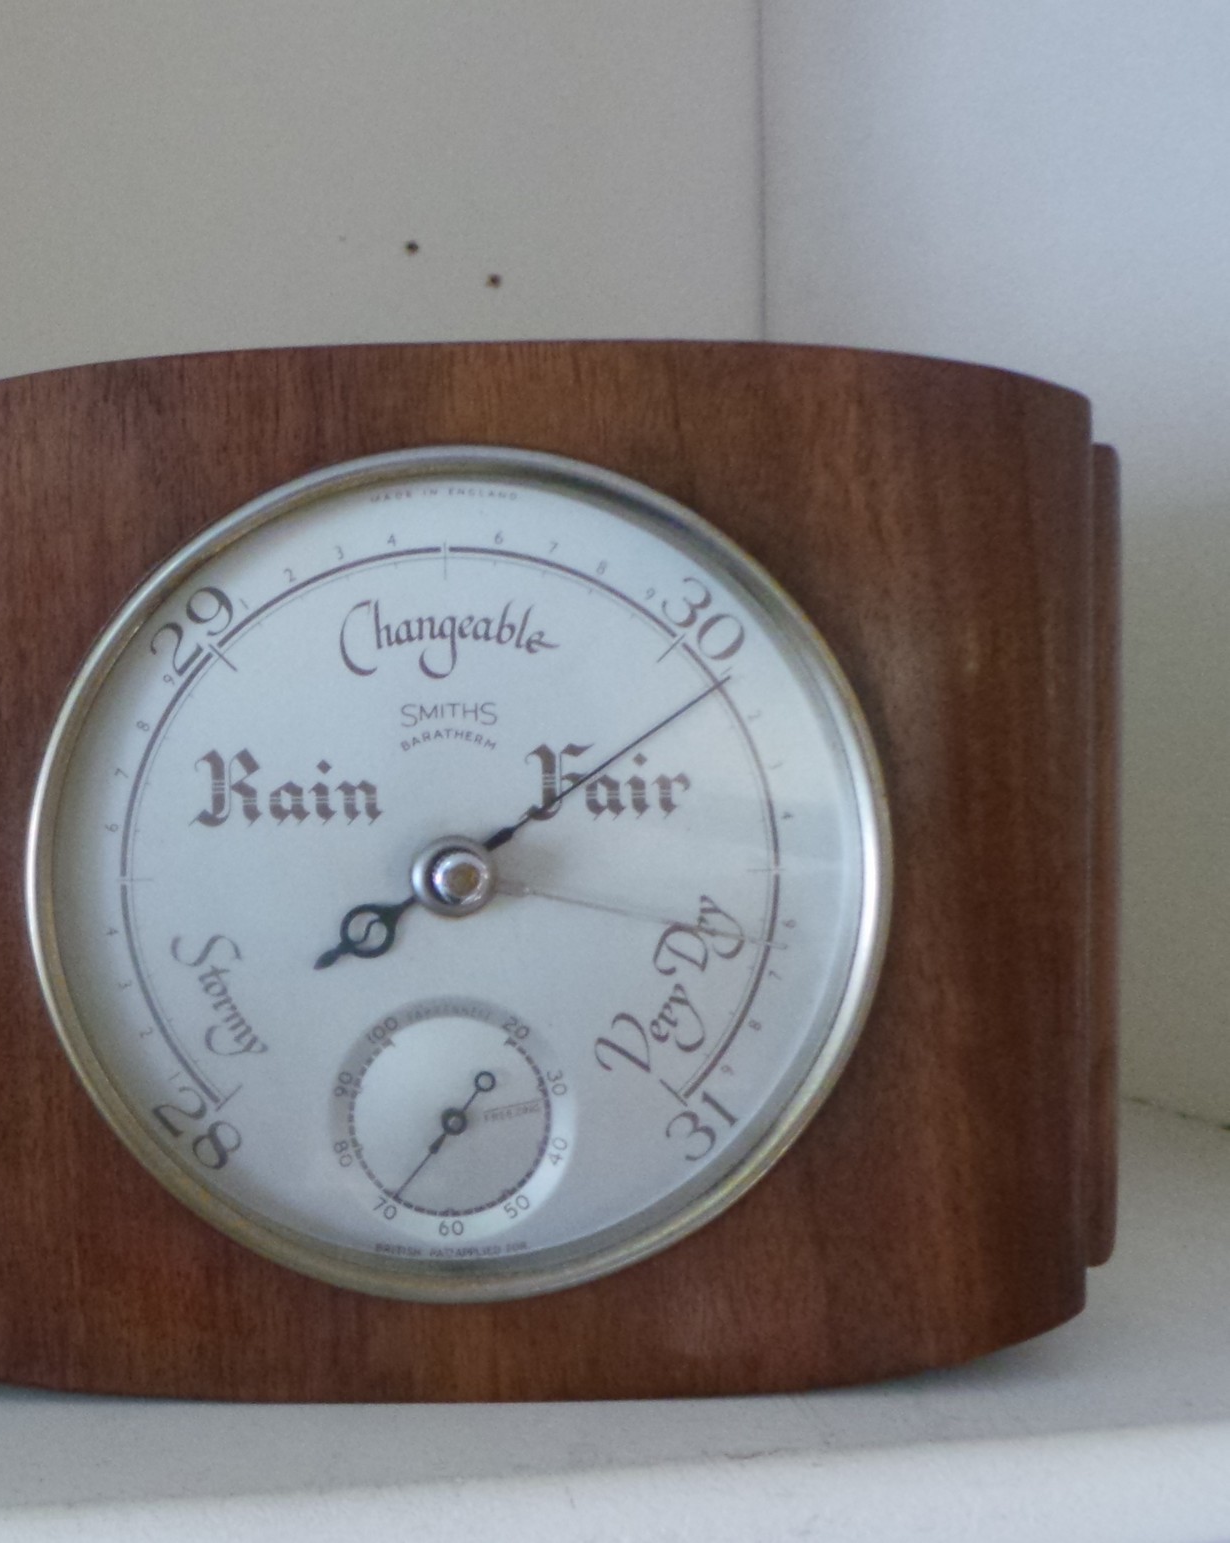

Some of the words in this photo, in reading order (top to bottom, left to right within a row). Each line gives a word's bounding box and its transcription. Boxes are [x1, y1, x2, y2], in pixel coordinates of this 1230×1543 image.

[423, 487, 438, 496] IN
[448, 487, 519, 501] ENGLAND
[387, 533, 397, 547] 4
[494, 530, 504, 545] 6
[149, 586, 234, 677] 29
[661, 576, 746, 662] 30
[340, 597, 561, 680] Changeable
[400, 702, 498, 728] SMITHS
[400, 727, 497, 752] BARATHERM
[188, 747, 384, 826] Rain
[525, 742, 692, 822] Fair
[171, 934, 269, 1057] Stormy
[594, 983, 706, 1074] Very
[653, 895, 746, 977] Dry
[368, 1015, 399, 1044] 100
[501, 1016, 530, 1040] 20
[333, 1071, 353, 1098] 90
[546, 1069, 568, 1096] 30
[152, 1086, 243, 1170] 28
[665, 1091, 739, 1162] 31
[333, 1139, 353, 1168] 80
[548, 1136, 568, 1166] 40
[372, 1197, 398, 1221] 70
[503, 1194, 531, 1220] 50
[438, 1220, 465, 1237] 60
